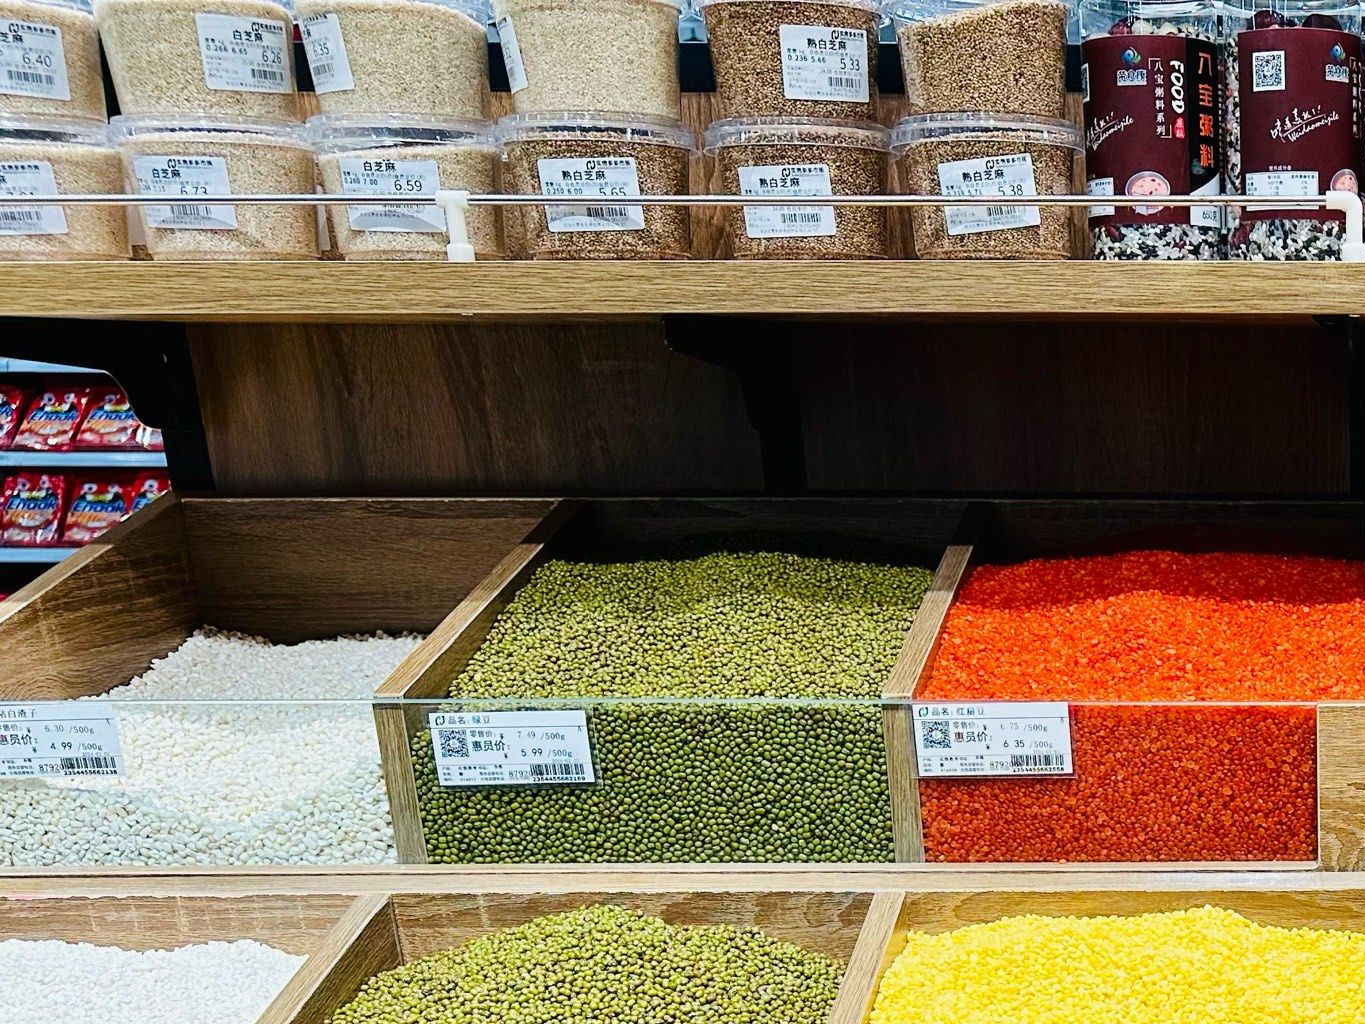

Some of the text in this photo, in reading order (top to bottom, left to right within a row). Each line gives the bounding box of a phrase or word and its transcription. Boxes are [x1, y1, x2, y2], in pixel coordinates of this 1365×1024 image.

[233, 30, 263, 42] 白芝麻
[807, 38, 847, 51] 熟白芝麻
[23, 54, 52, 67] 6.40
[262, 51, 282, 64] 6.26
[840, 58, 860, 71] 5.33
[1170, 60, 1185, 113] FOOD
[364, 161, 396, 172] 白芝麻
[152, 168, 181, 178] 白芝麻
[562, 170, 606, 181] 熟白芝麻
[962, 169, 1004, 182] 熟白芝麻
[395, 180, 422, 191] 6.59
[759, 178, 800, 188] 熟白芝麻
[998, 184, 1023, 196] 5.38
[70, 726, 94, 734] /500g
[1023, 724, 1047, 732] /500g
[541, 732, 565, 741] /500g
[78, 743, 102, 751] /500g
[1029, 741, 1053, 749] /500g
[547, 749, 572, 757] /500g
